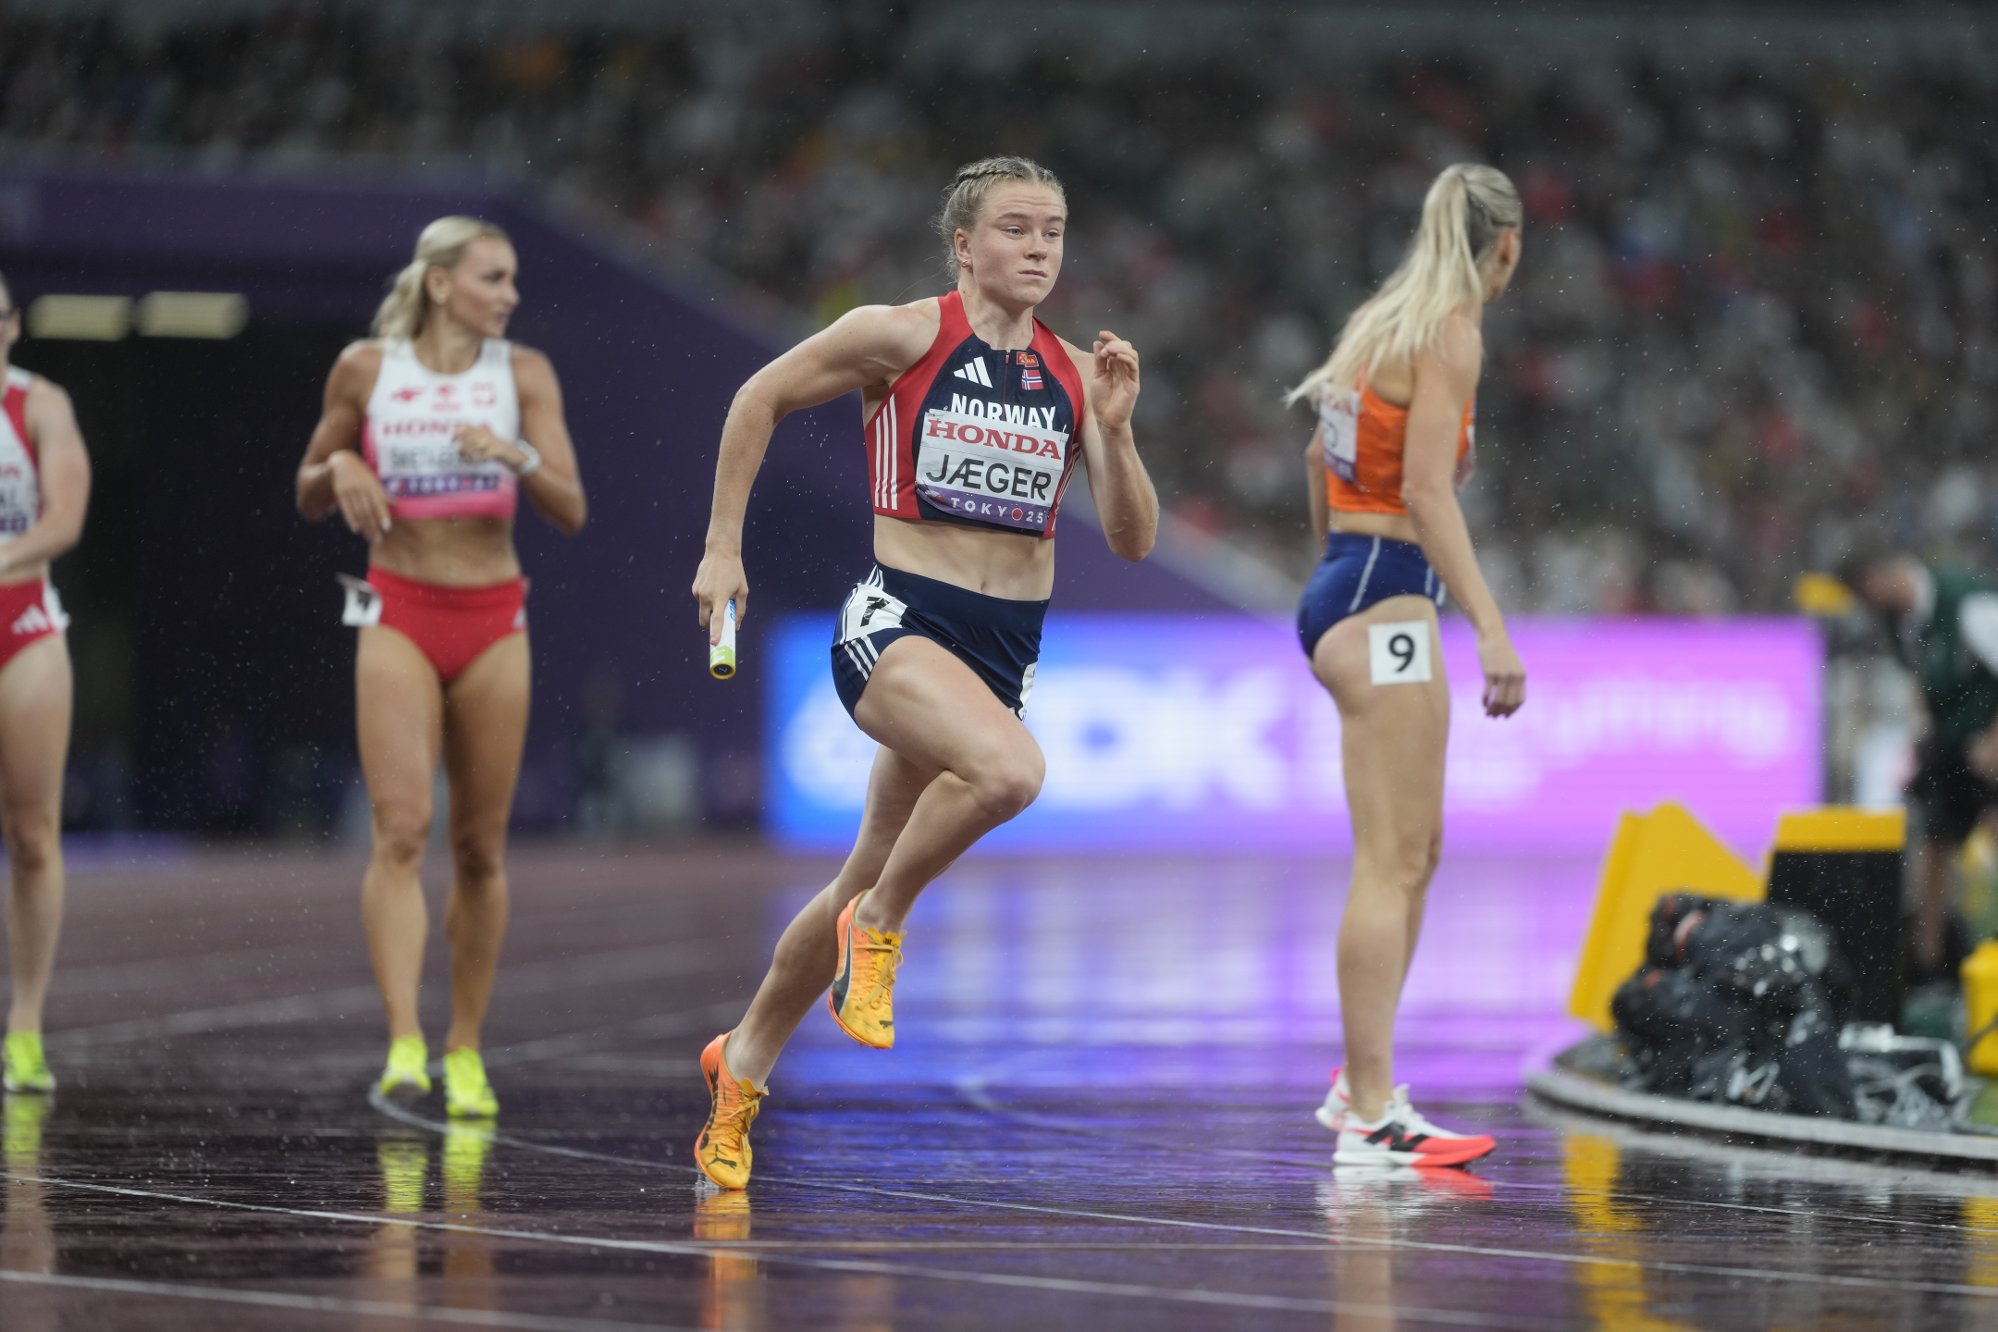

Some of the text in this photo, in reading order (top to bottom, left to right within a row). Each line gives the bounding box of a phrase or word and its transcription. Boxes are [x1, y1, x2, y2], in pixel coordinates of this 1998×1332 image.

[951, 392, 1057, 431] NORWAY
[926, 418, 1062, 460] HONDA
[925, 454, 1052, 501] JÆGER
[1388, 634, 1415, 674] 9
